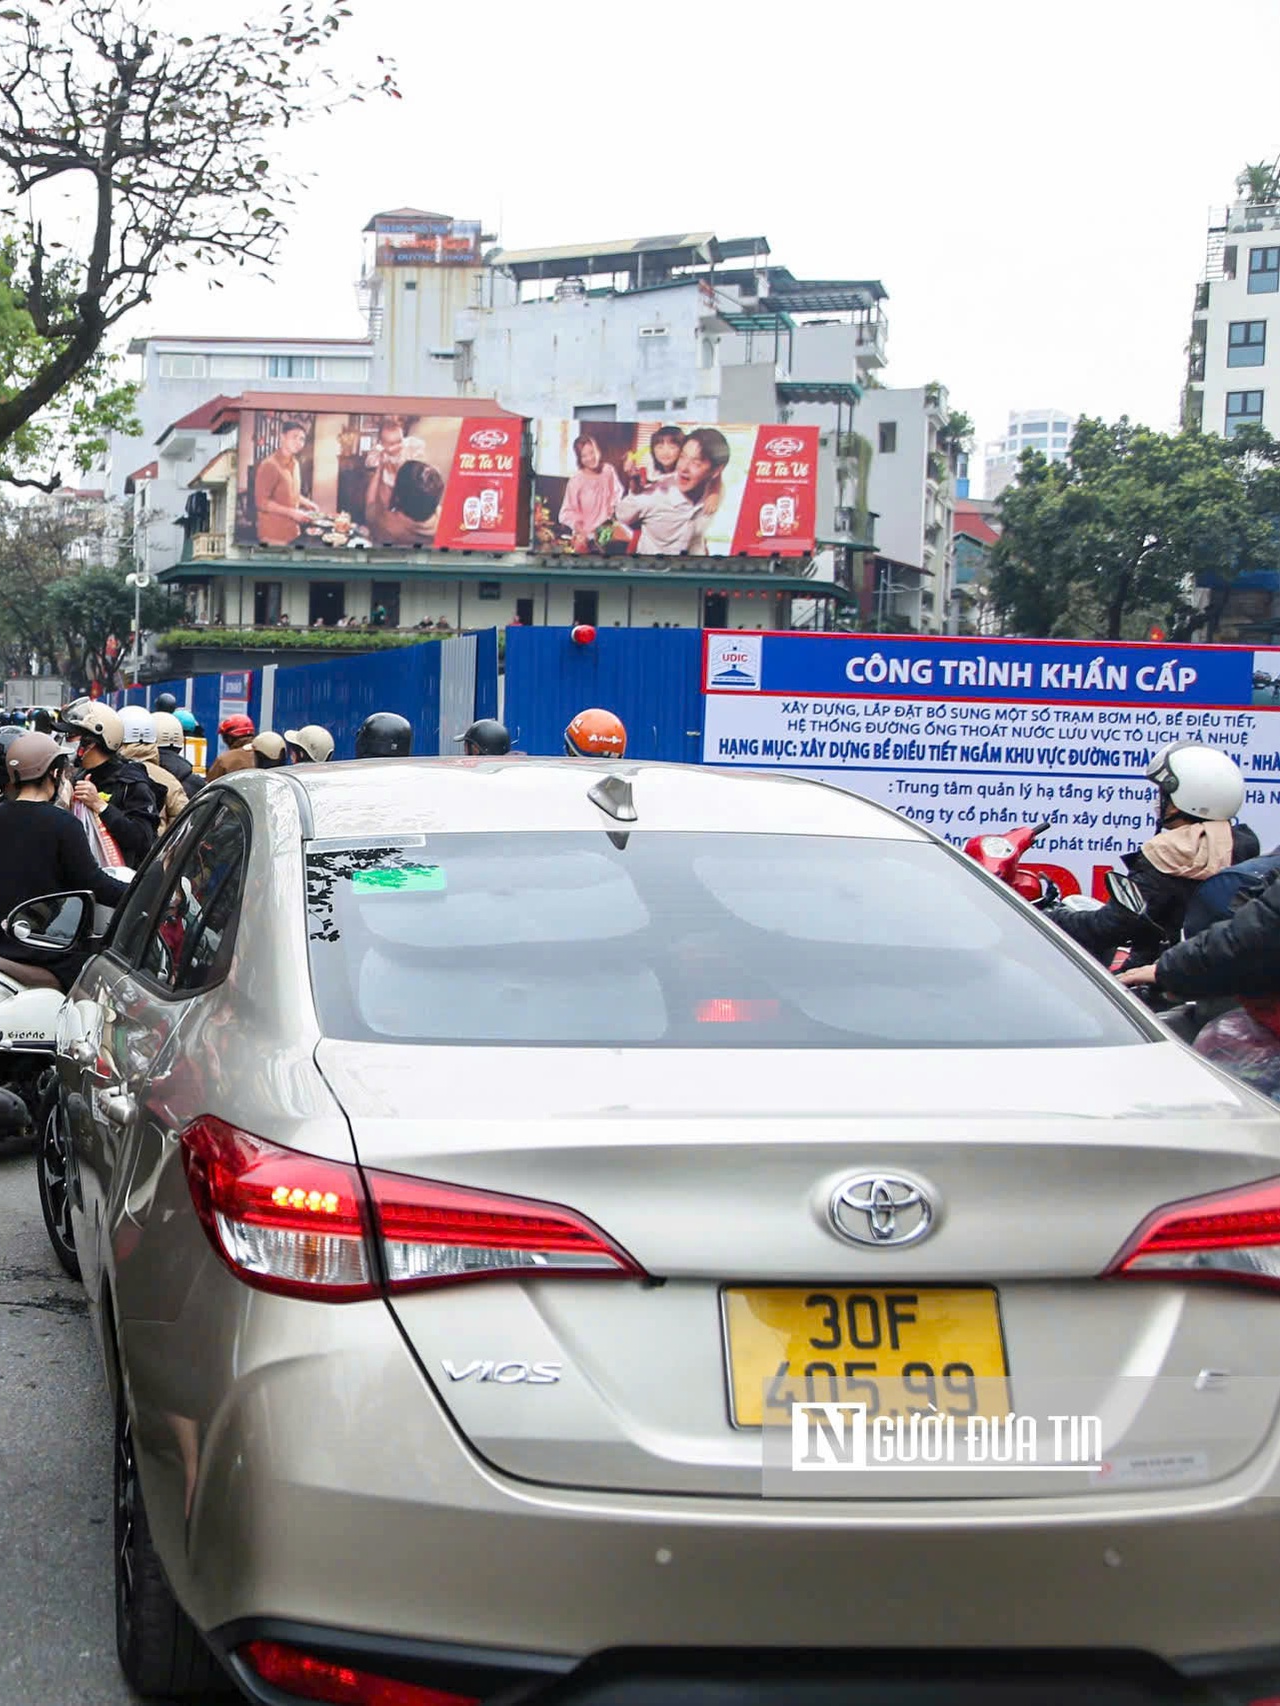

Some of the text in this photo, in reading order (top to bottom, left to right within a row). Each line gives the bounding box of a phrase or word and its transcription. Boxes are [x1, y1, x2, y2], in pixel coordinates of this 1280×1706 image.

[722, 653, 748, 662] UDIC
[846, 652, 1198, 692] CÔNG TRÌNH KHẨN CẤP
[781, 702, 809, 716] XÂY
[813, 703, 860, 719] DỰNG,
[864, 702, 890, 717] LẮP
[894, 704, 922, 720] ĐẶT
[951, 707, 991, 720] SUNG
[995, 708, 1027, 723] MỘT
[1031, 707, 1051, 722] SỐ
[1054, 711, 1094, 728] TRẠM
[1098, 711, 1131, 725] BƠM
[1186, 711, 1221, 728] ĐIỀU
[1224, 714, 1257, 730] TIẾT,
[788, 719, 806, 733] HỆ
[810, 718, 862, 734] THỐNG
[866, 720, 921, 735] ĐƯỜNG
[924, 722, 957, 737] ỐNG
[960, 724, 1007, 738] THOÁT
[1012, 725, 1055, 740] NƯỚC
[1059, 727, 1088, 740] LƯU
[1091, 728, 1121, 744] VỰC
[1124, 727, 1143, 742] TÔ
[1208, 731, 1248, 747] NHUỆ
[719, 738, 758, 761] HẠNG
[762, 740, 797, 762] MỤC:
[800, 738, 827, 758] XÂY
[829, 740, 871, 763] DỰNG
[874, 738, 891, 760] BỂ
[893, 739, 925, 761] ĐIỀU
[928, 739, 957, 762] TIẾT
[961, 741, 1002, 764] NGẦM
[1005, 747, 1035, 765] KHU
[1037, 748, 1065, 769] VỰC
[1070, 749, 1120, 767] ĐƯỜNG
[896, 780, 939, 797] Trung
[944, 781, 972, 795] tâm
[977, 782, 1015, 799] quản
[1020, 783, 1032, 800] lý
[1037, 783, 1054, 800] hạ
[1059, 784, 1093, 802] tầng
[1098, 785, 1114, 802] kỹ
[1245, 790, 1265, 804] Hà
[940, 808, 953, 823] ty
[958, 806, 975, 821] cổ
[980, 807, 1017, 824] phần
[1022, 810, 1038, 823] tư
[1042, 809, 1068, 824] vấn
[1073, 811, 1098, 828] xây
[1102, 812, 1141, 829] dựng
[1050, 836, 1083, 852] phát
[1088, 836, 1122, 851] triển
[808, 1293, 919, 1351] 30F
[441, 1358, 563, 1385] VIOS
[767, 1362, 978, 1418] 405.99
